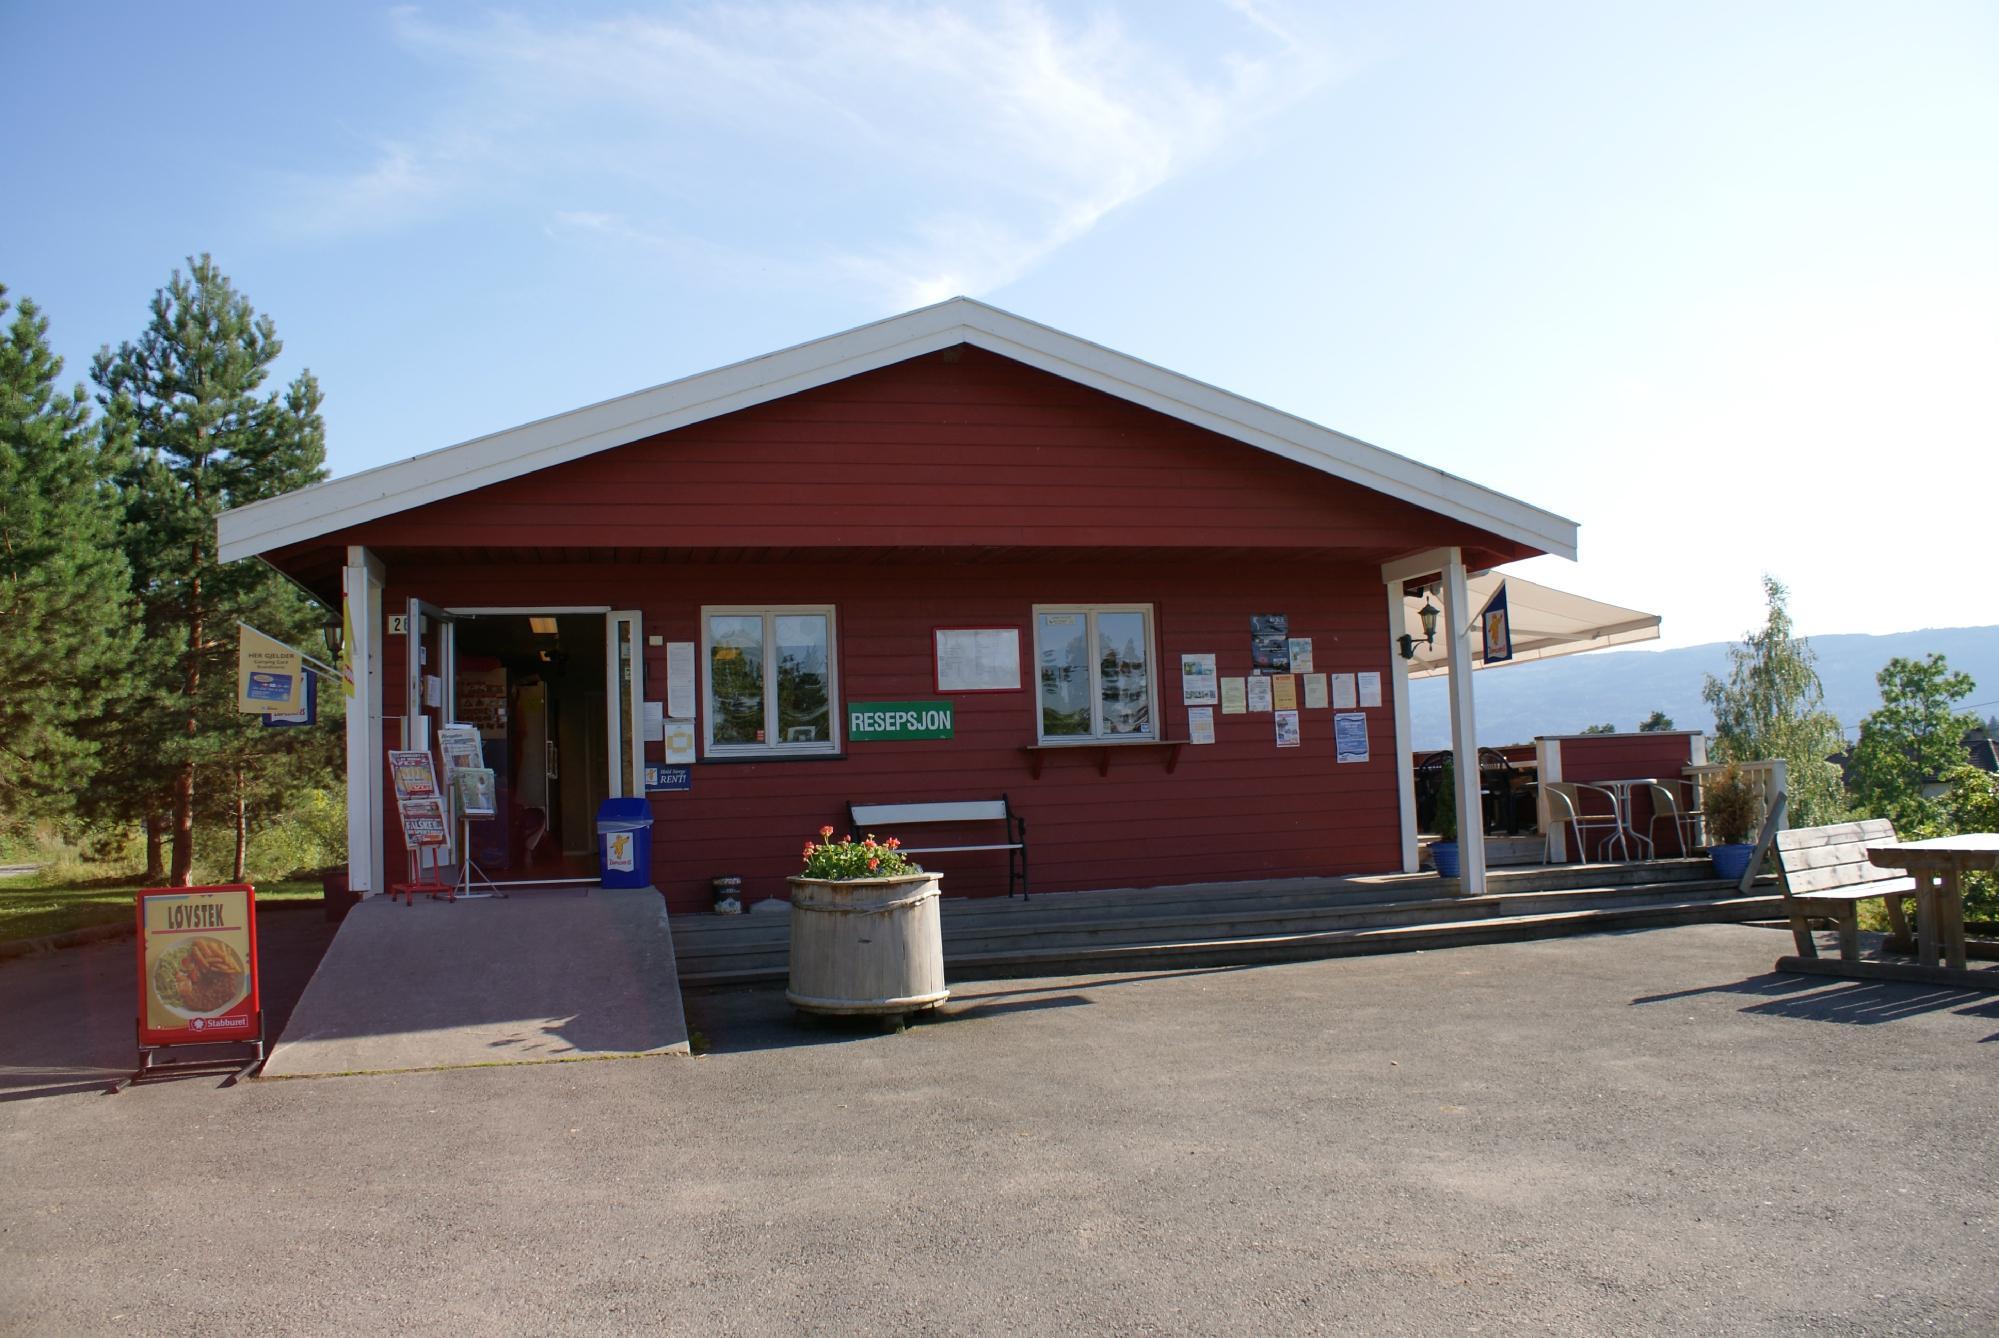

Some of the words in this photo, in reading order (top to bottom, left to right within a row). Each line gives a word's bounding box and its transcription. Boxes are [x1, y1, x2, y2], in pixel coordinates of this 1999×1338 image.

[851, 710, 951, 732] RESEPSJON
[660, 775, 686, 784] RENT!
[168, 903, 224, 929] LØVSTEK
[208, 1018, 246, 1028] Stabburet
